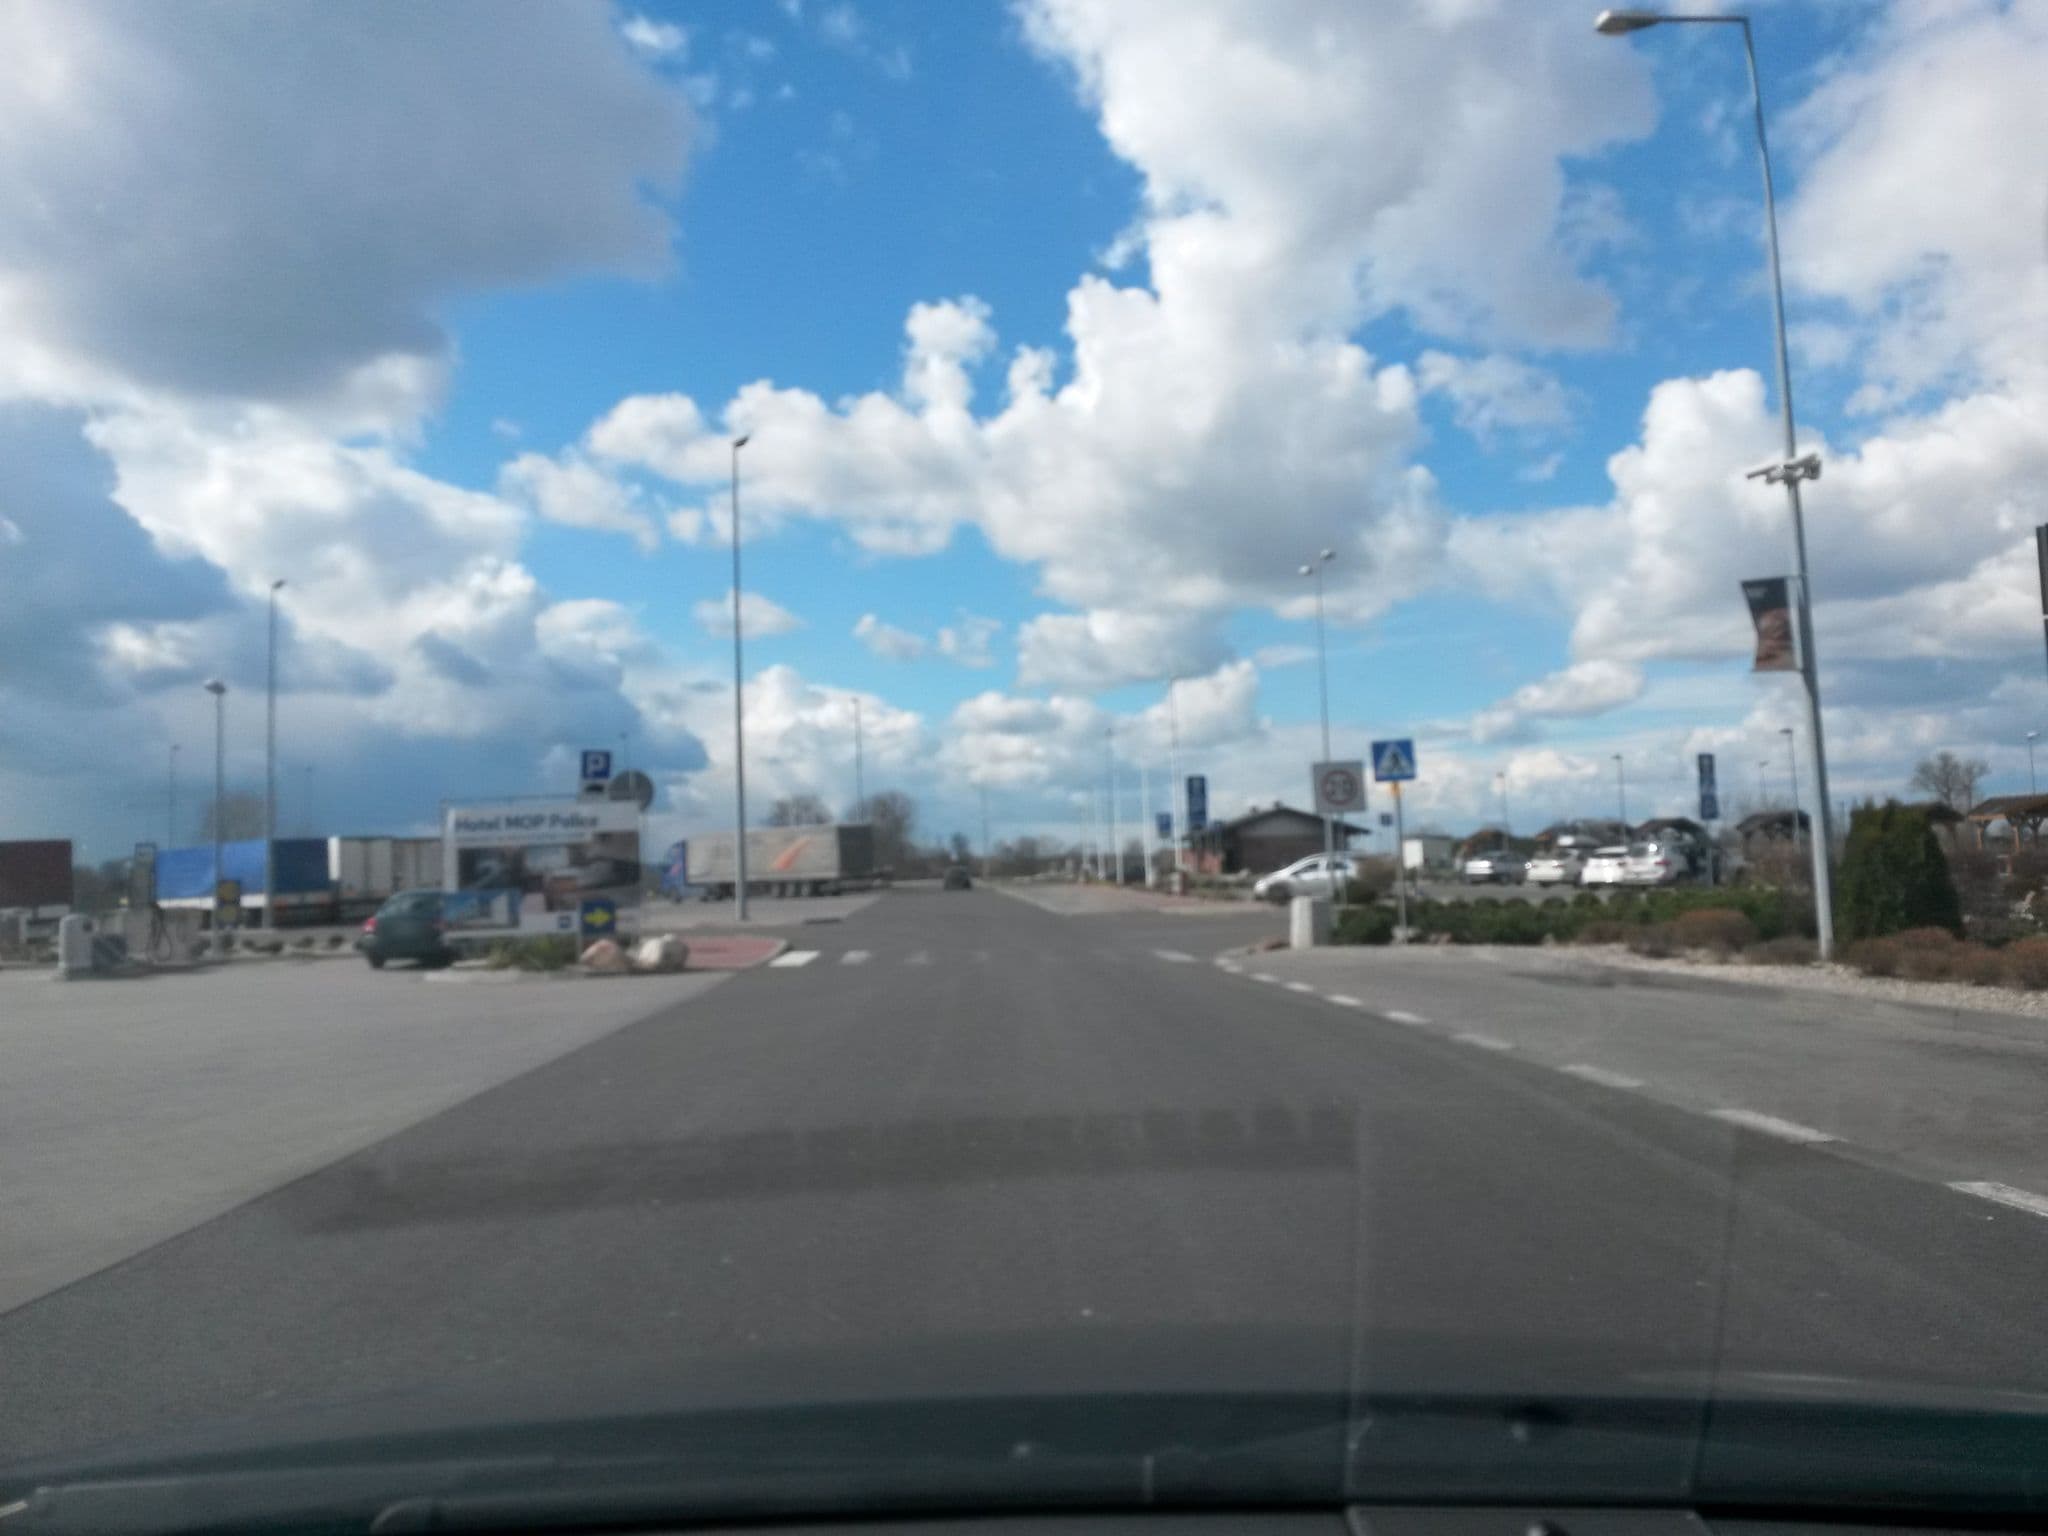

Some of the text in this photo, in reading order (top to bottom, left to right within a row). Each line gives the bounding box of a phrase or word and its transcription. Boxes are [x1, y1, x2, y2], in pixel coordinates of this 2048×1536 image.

[587, 754, 605, 777] P
[455, 815, 499, 833] Hotel
[505, 812, 545, 830] MOP
